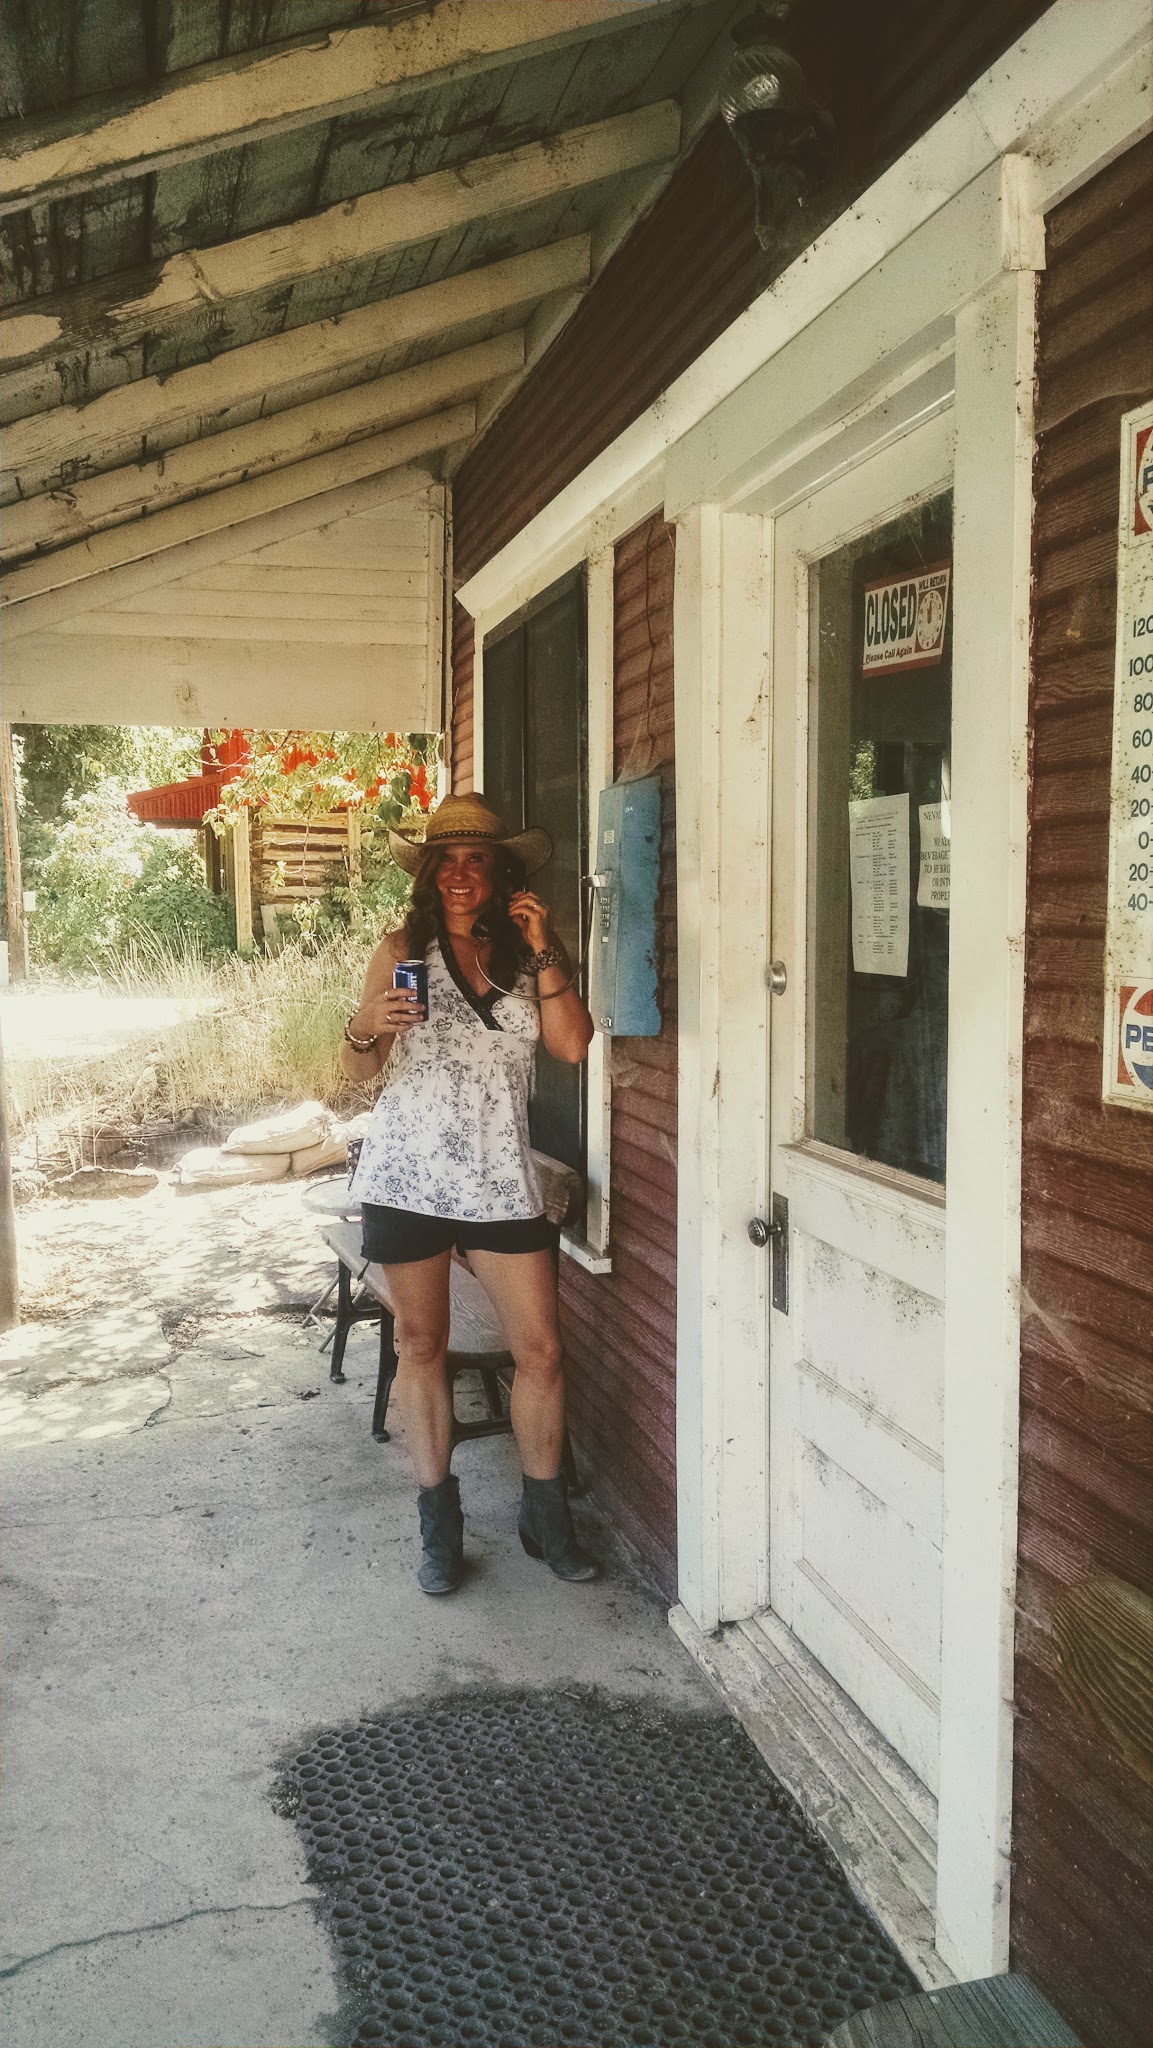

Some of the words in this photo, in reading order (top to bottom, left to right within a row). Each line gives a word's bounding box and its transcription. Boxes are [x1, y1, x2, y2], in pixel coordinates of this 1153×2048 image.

[930, 574, 947, 587] RETURN
[866, 583, 918, 648] CLOSED
[865, 653, 883, 664] Please
[885, 649, 896, 660] Call
[896, 645, 913, 658] Again
[1129, 654, 1153, 677] 100
[1134, 692, 1153, 713] 80
[1132, 728, 1153, 749] 60
[1131, 764, 1152, 784] 40
[923, 811, 941, 821] NEVA
[1131, 798, 1150, 817] 20
[1138, 831, 1150, 850] 0
[920, 850, 950, 861] BEVERAGE
[1129, 863, 1149, 881] 20
[1128, 893, 1148, 911] 40
